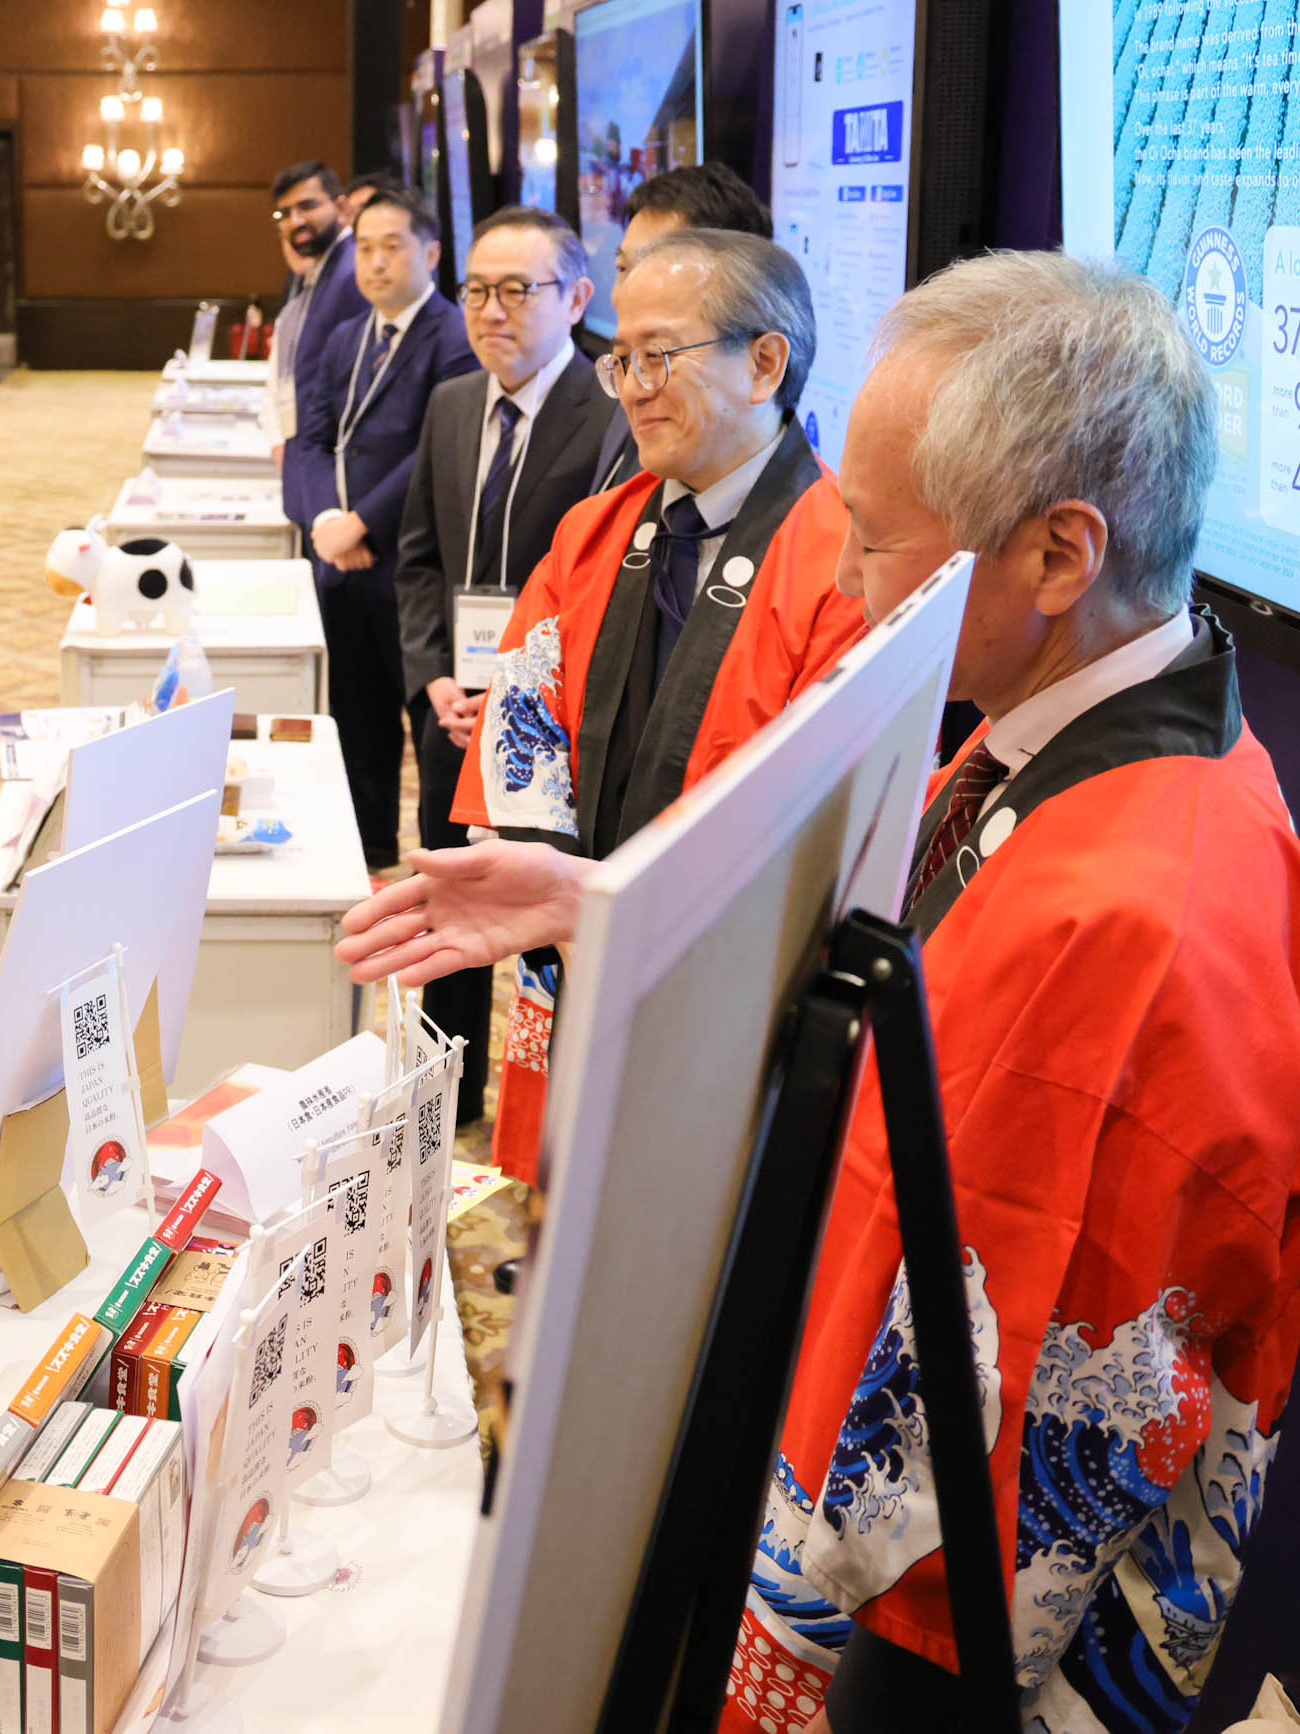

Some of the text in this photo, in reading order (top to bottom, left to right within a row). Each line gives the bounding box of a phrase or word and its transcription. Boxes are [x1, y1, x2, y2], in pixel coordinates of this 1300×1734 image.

[1176, 36, 1200, 49] name
[1202, 33, 1219, 46] was
[1221, 25, 1258, 44] derived
[1260, 20, 1284, 38] from
[1181, 56, 1206, 73] which
[1208, 56, 1238, 71] means
[1262, 52, 1279, 67] tea
[1190, 85, 1209, 102] part
[1210, 81, 1221, 98] of
[1222, 80, 1237, 97] the
[1134, 120, 1151, 137] Over
[1170, 119, 1186, 136] last
[1161, 144, 1182, 160] Ocha
[1184, 142, 1209, 160] brand
[1211, 144, 1227, 160] has
[1229, 143, 1252, 160] been
[1255, 143, 1271, 160] the
[1193, 170, 1209, 186] and
[1211, 172, 1233, 186] taste
[1235, 168, 1277, 190] expands
[1278, 171, 1290, 188] to
[1192, 231, 1241, 273] GUINNESS
[1187, 285, 1208, 355] WORLD
[1210, 290, 1245, 363] RECORDS
[1273, 384, 1293, 400] more
[1271, 460, 1292, 475] more
[473, 629, 496, 642] VIP
[79, 1064, 97, 1081] THIS
[82, 1077, 103, 1095] JAPAN
[82, 1085, 114, 1108] QUALITY
